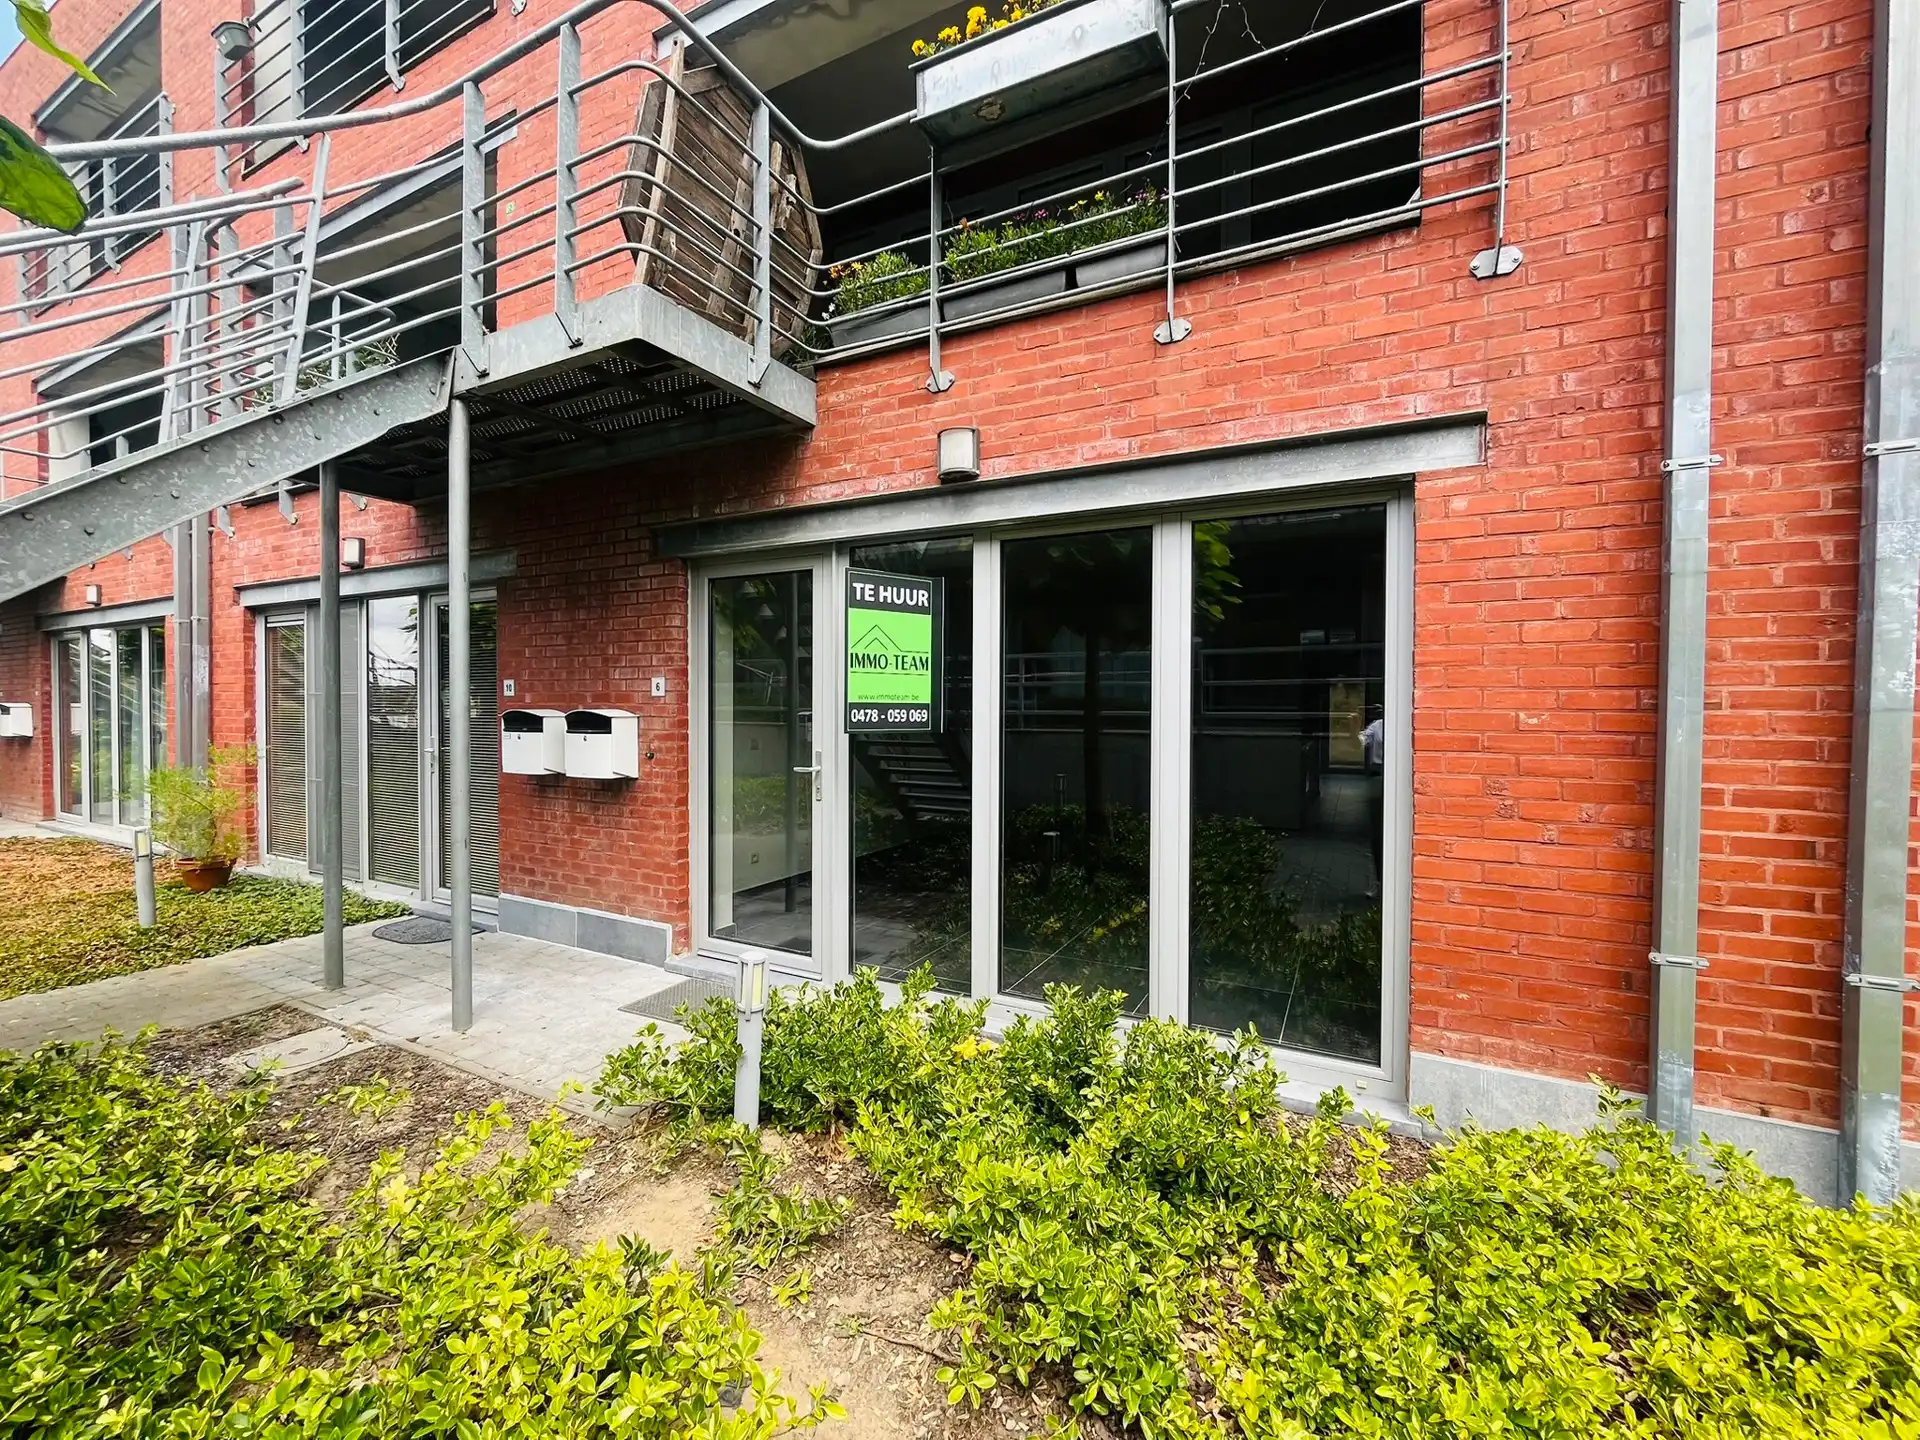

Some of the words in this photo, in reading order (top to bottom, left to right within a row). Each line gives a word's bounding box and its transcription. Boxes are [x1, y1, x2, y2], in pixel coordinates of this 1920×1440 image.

[852, 582, 876, 602] TE
[879, 586, 929, 607] HUUR
[850, 652, 929, 672] IMMO-TEAM
[505, 683, 513, 692] 10
[655, 682, 661, 691] 6
[850, 708, 879, 723] 0478
[887, 708, 907, 723] 059
[908, 708, 928, 723] 069
